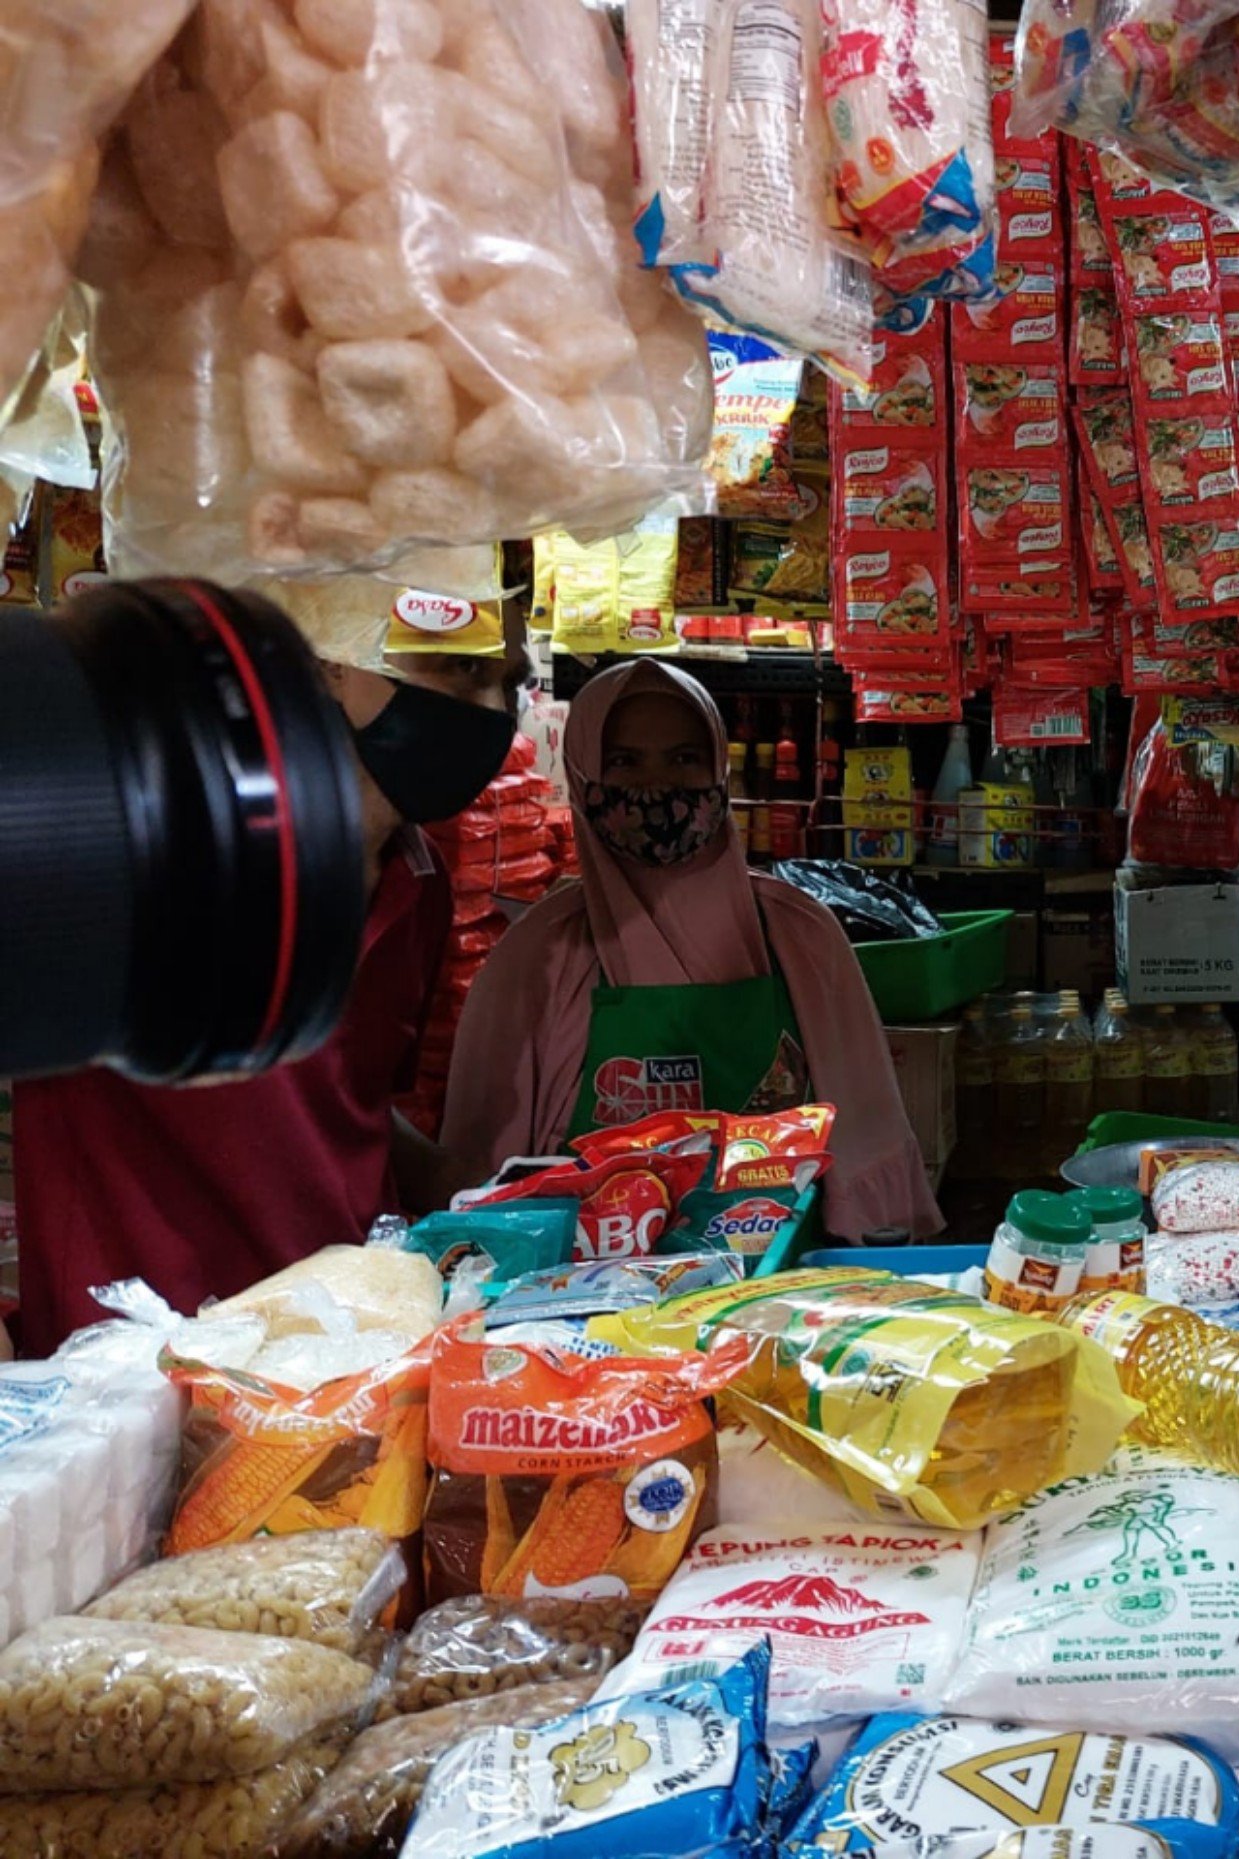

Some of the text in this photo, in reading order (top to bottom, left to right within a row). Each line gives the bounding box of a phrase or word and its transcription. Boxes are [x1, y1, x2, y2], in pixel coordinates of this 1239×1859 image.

[714, 393, 788, 417] empe
[848, 455, 885, 470] Royco
[849, 559, 887, 574] Royco
[404, 594, 466, 627] Sasa
[1214, 959, 1234, 971] KG
[650, 1061, 696, 1084] kara
[593, 1057, 703, 1125] SUN
[737, 1165, 789, 1184] GRATIS
[573, 1208, 670, 1259] ABC
[705, 1214, 789, 1238] Sedaa
[518, 1457, 560, 1470] CORN
[822, 1534, 964, 1553] TAPIOKA
[789, 1562, 838, 1574] CAP
[656, 1612, 919, 1638] GUNUNG AGUNG
[1052, 1650, 1101, 1663] BERAT
[1105, 1649, 1161, 1661] BERSIH
[1174, 1647, 1206, 1658] 1000
[1209, 1650, 1225, 1662] gr
[1017, 1676, 1042, 1686] BAIK
[1047, 1673, 1113, 1685] DIGUNAKAN
[1116, 1670, 1168, 1682] SEBELUM
